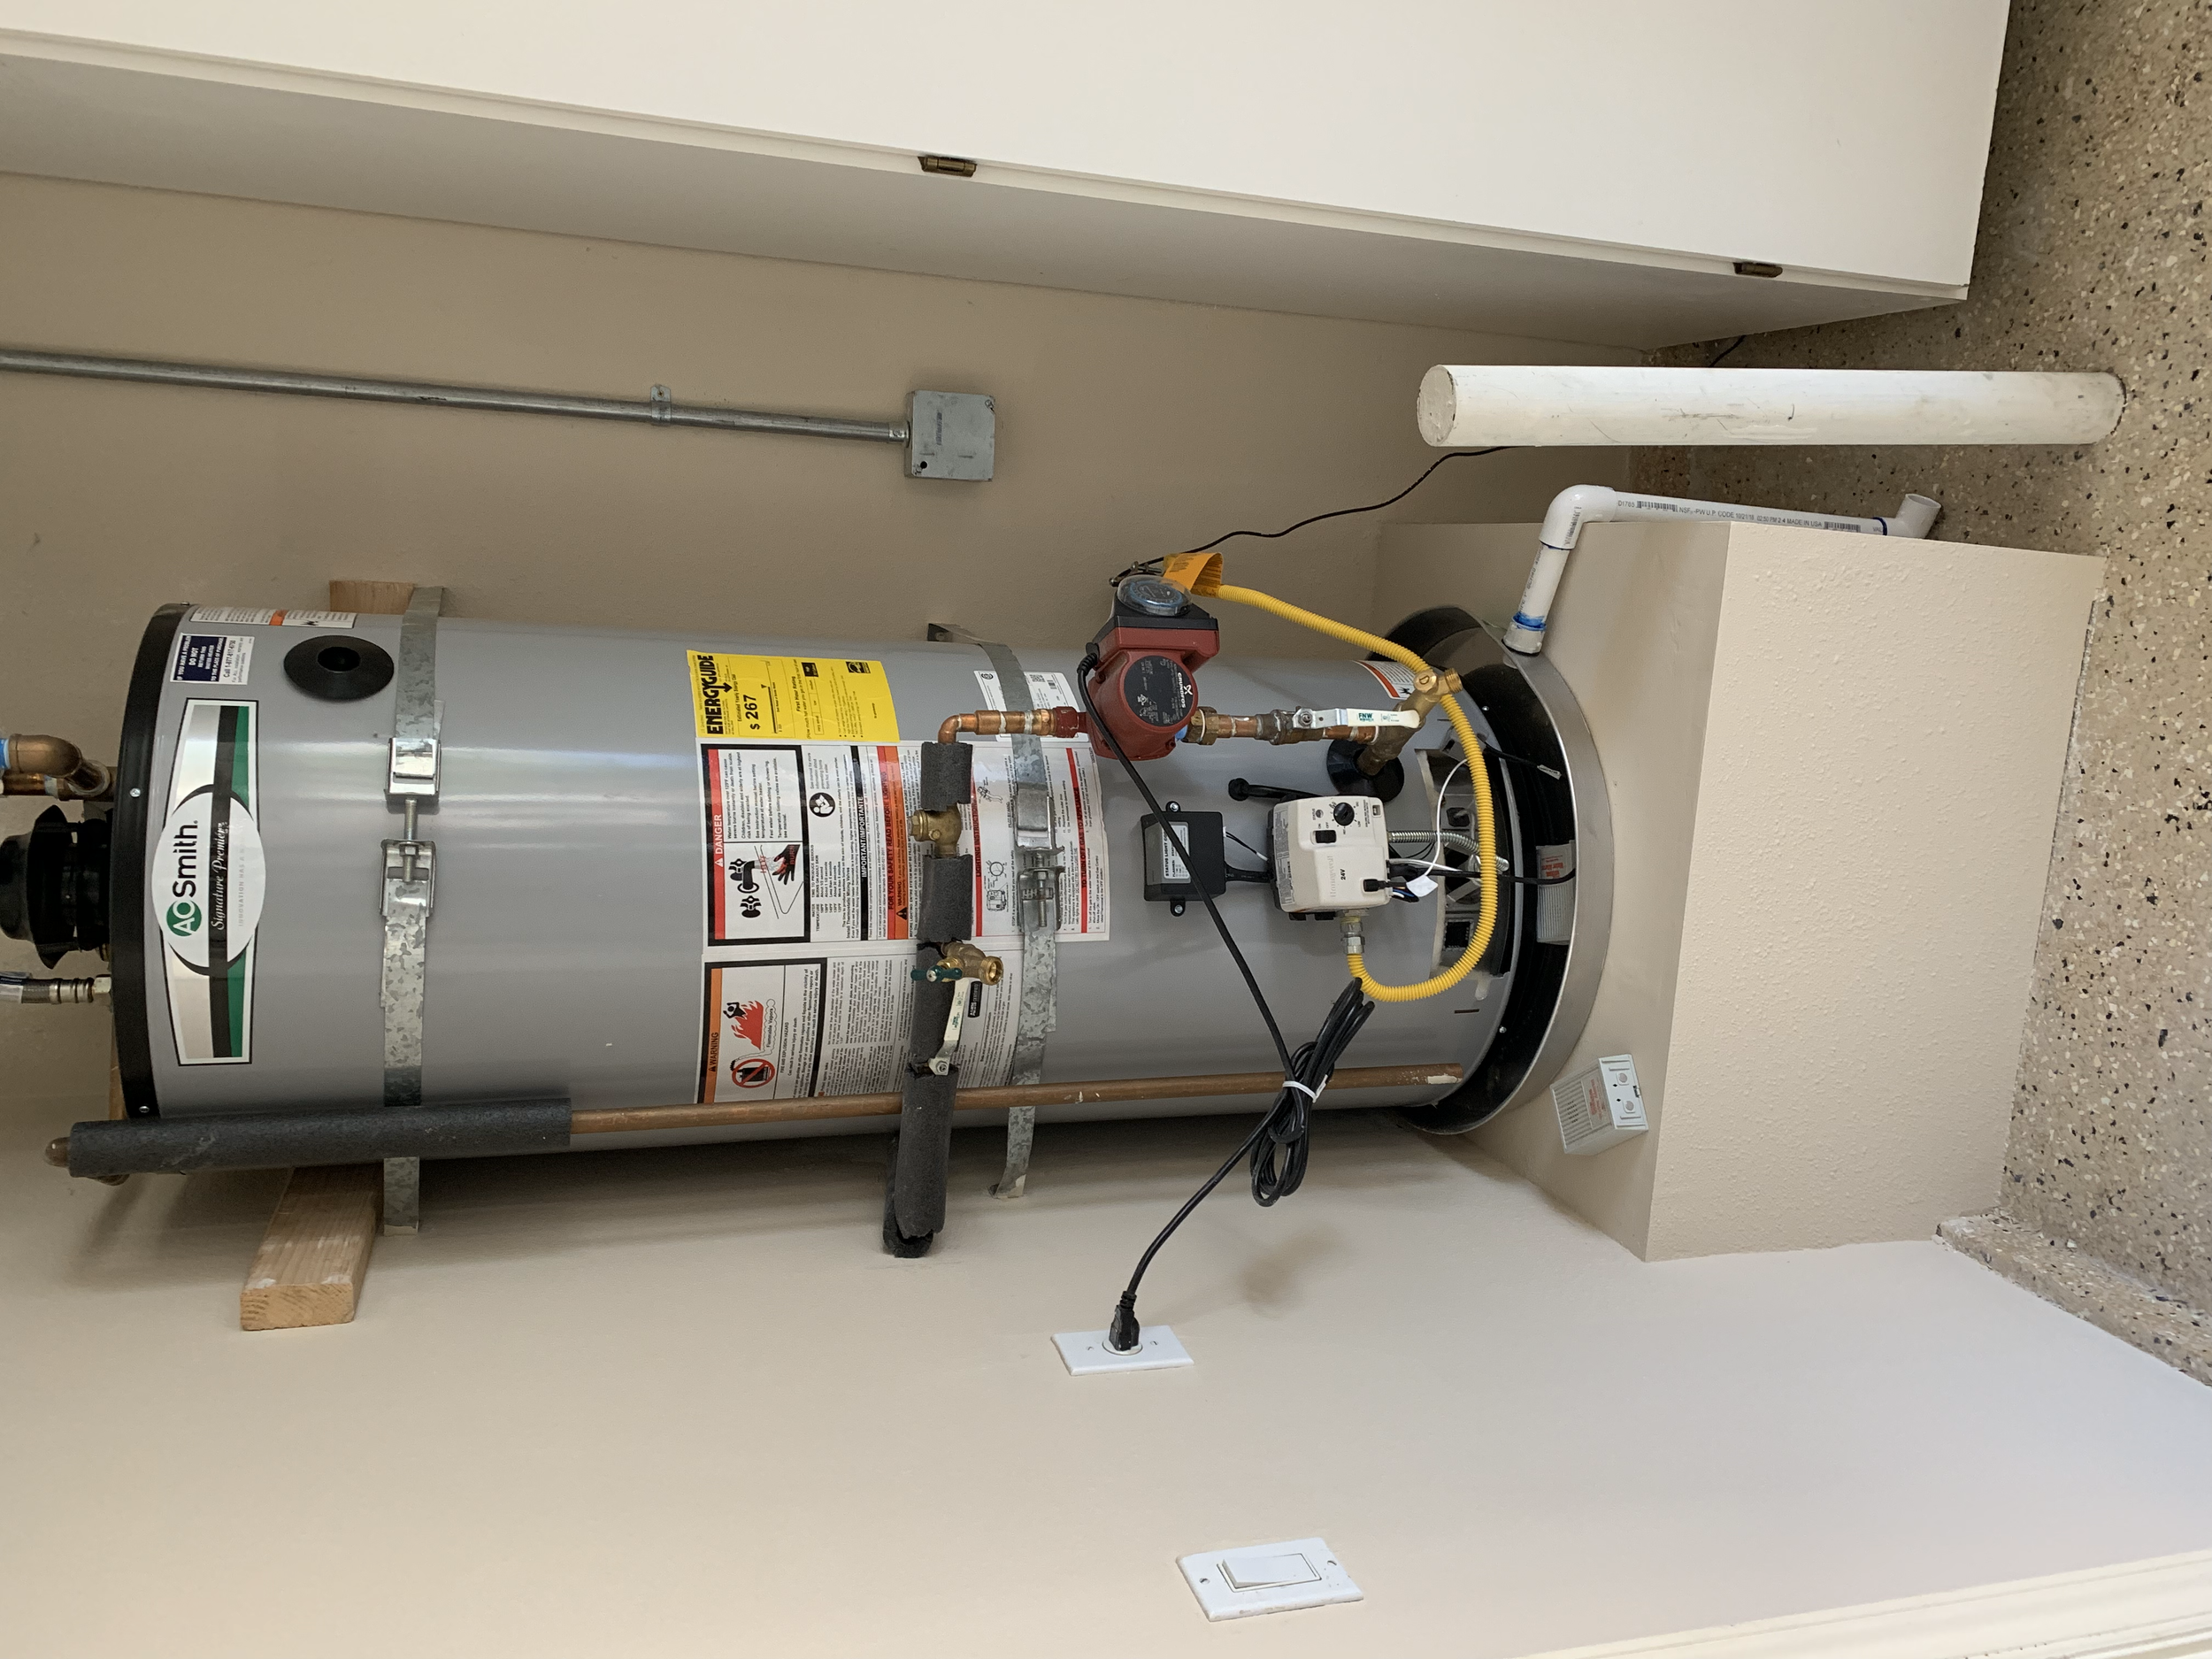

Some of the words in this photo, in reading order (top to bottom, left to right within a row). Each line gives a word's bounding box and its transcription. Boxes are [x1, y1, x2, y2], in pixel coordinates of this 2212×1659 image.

[697, 655, 723, 734] ENERGYGUIDE
[743, 695, 758, 719] 267
[1073, 787, 1083, 820] APPLIANCE
[714, 815, 723, 854] DANGER
[857, 796, 867, 877] IMPORTANT/IMPORTANTE
[1327, 856, 1337, 897] Honeywell
[211, 876, 225, 930] Signature
[710, 1033, 718, 1065] WARNING
